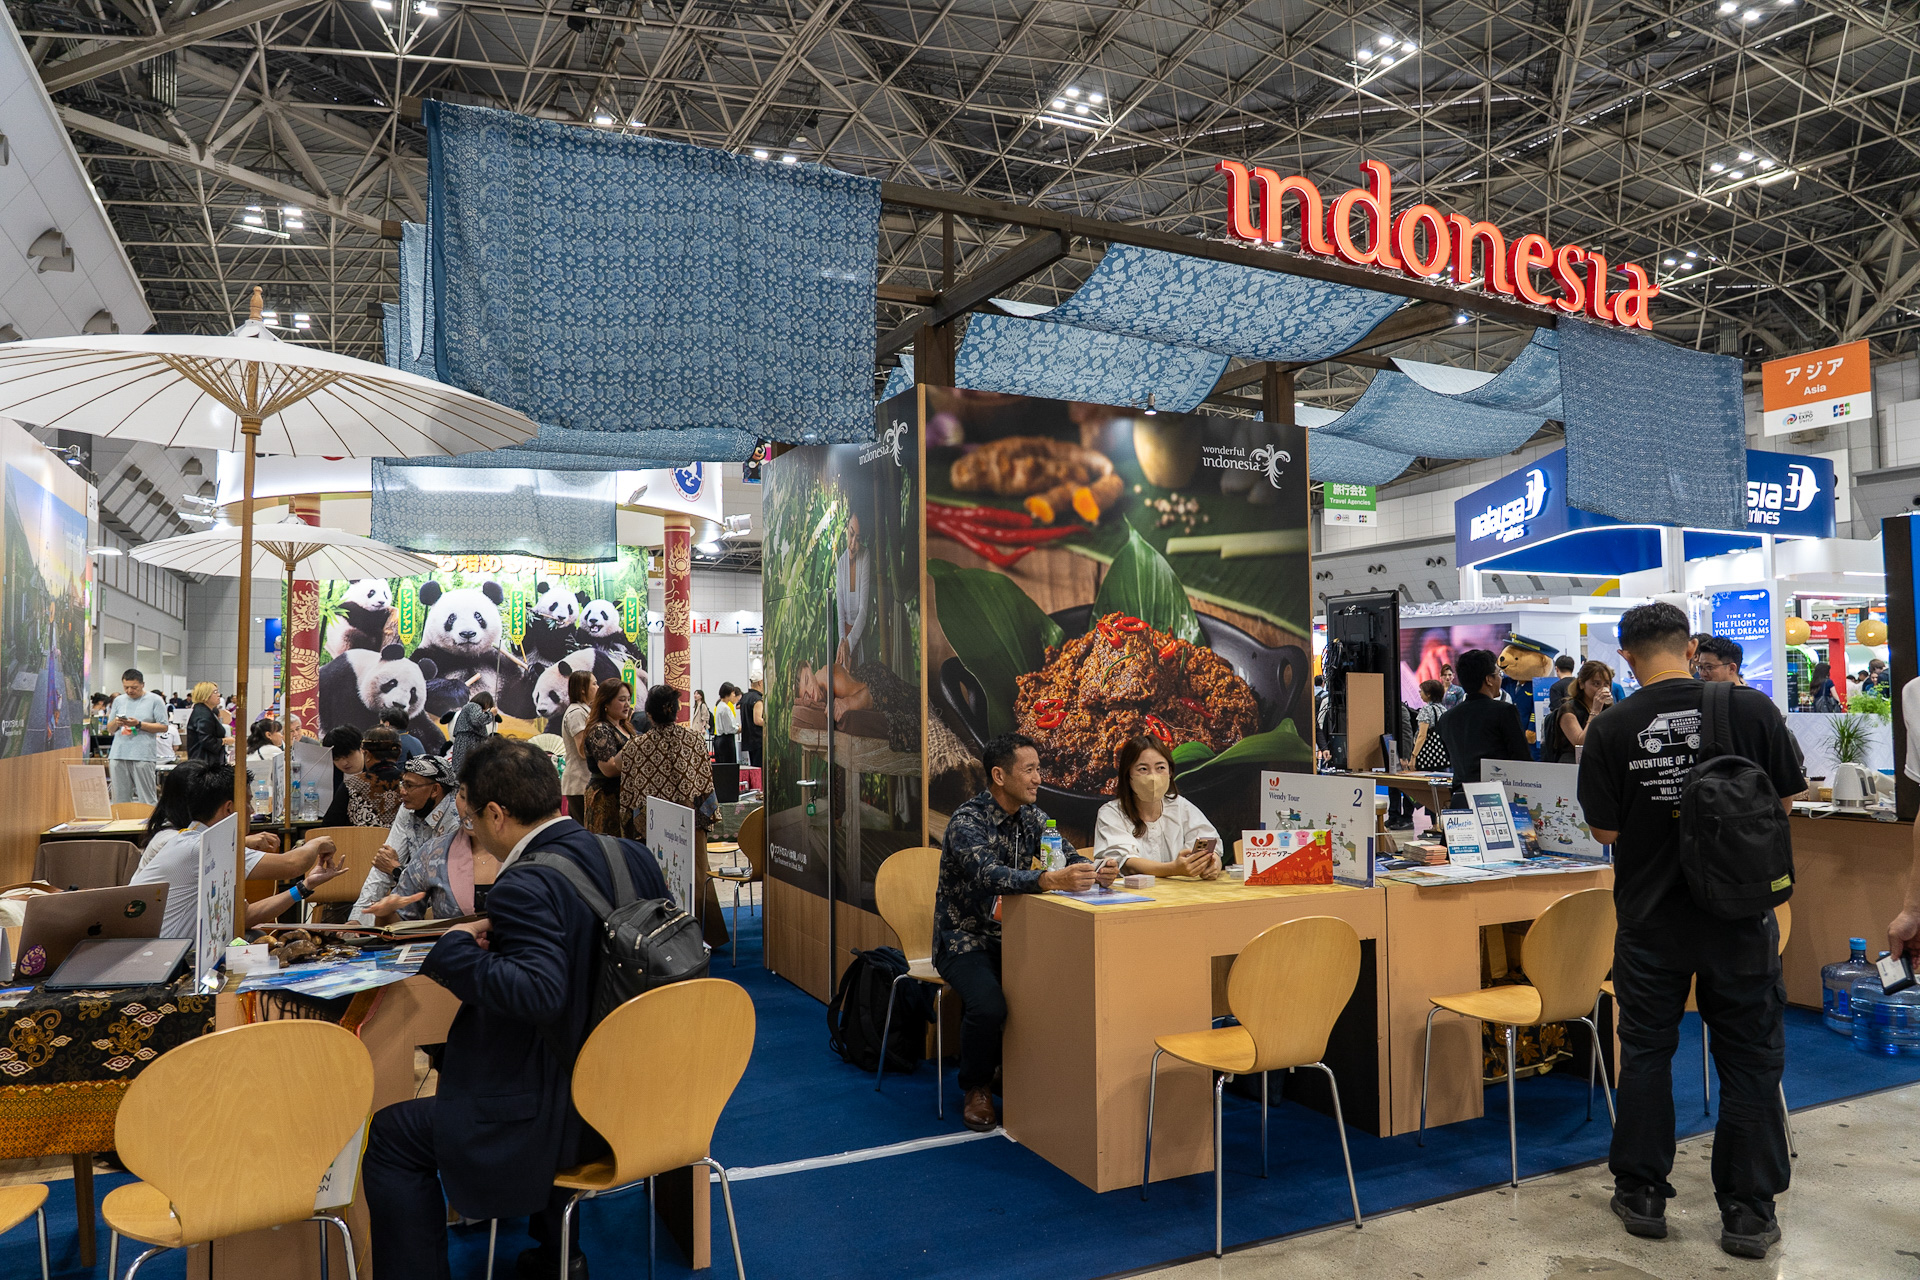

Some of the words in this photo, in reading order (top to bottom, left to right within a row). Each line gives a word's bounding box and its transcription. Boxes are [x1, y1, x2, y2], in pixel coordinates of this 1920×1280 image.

[1215, 159, 1660, 331] indonesia
[1785, 357, 1844, 385] アジア
[1804, 384, 1827, 396] Asia
[859, 445, 889, 465] indonesia
[1202, 446, 1245, 456] wonderful
[1202, 455, 1260, 471] indonesia
[1333, 483, 1367, 496] 旅行会社
[1348, 498, 1371, 506] Agencies
[403, 590, 411, 633] シャンシャン
[513, 591, 522, 635] シャオシャオ
[1715, 621, 1728, 629] THE
[1731, 619, 1757, 628] FLIGHT
[1759, 618, 1769, 626] OF
[1715, 628, 1736, 636] YOUR
[1738, 627, 1769, 635] DREAMS
[1629, 756, 1673, 770] ADVENTURE
[1675, 755, 1686, 765] OF
[1689, 754, 1694, 763] A
[1658, 767, 1680, 776] WORLD
[1513, 779, 1542, 789] Indonesia
[1660, 786, 1677, 795] WILD
[1269, 792, 1286, 802] Wendy
[1288, 794, 1300, 802] Tour
[1352, 788, 1363, 807] 2
[650, 808, 654, 831] 3
[1446, 816, 1459, 826] All
[322, 1173, 331, 1182] N
